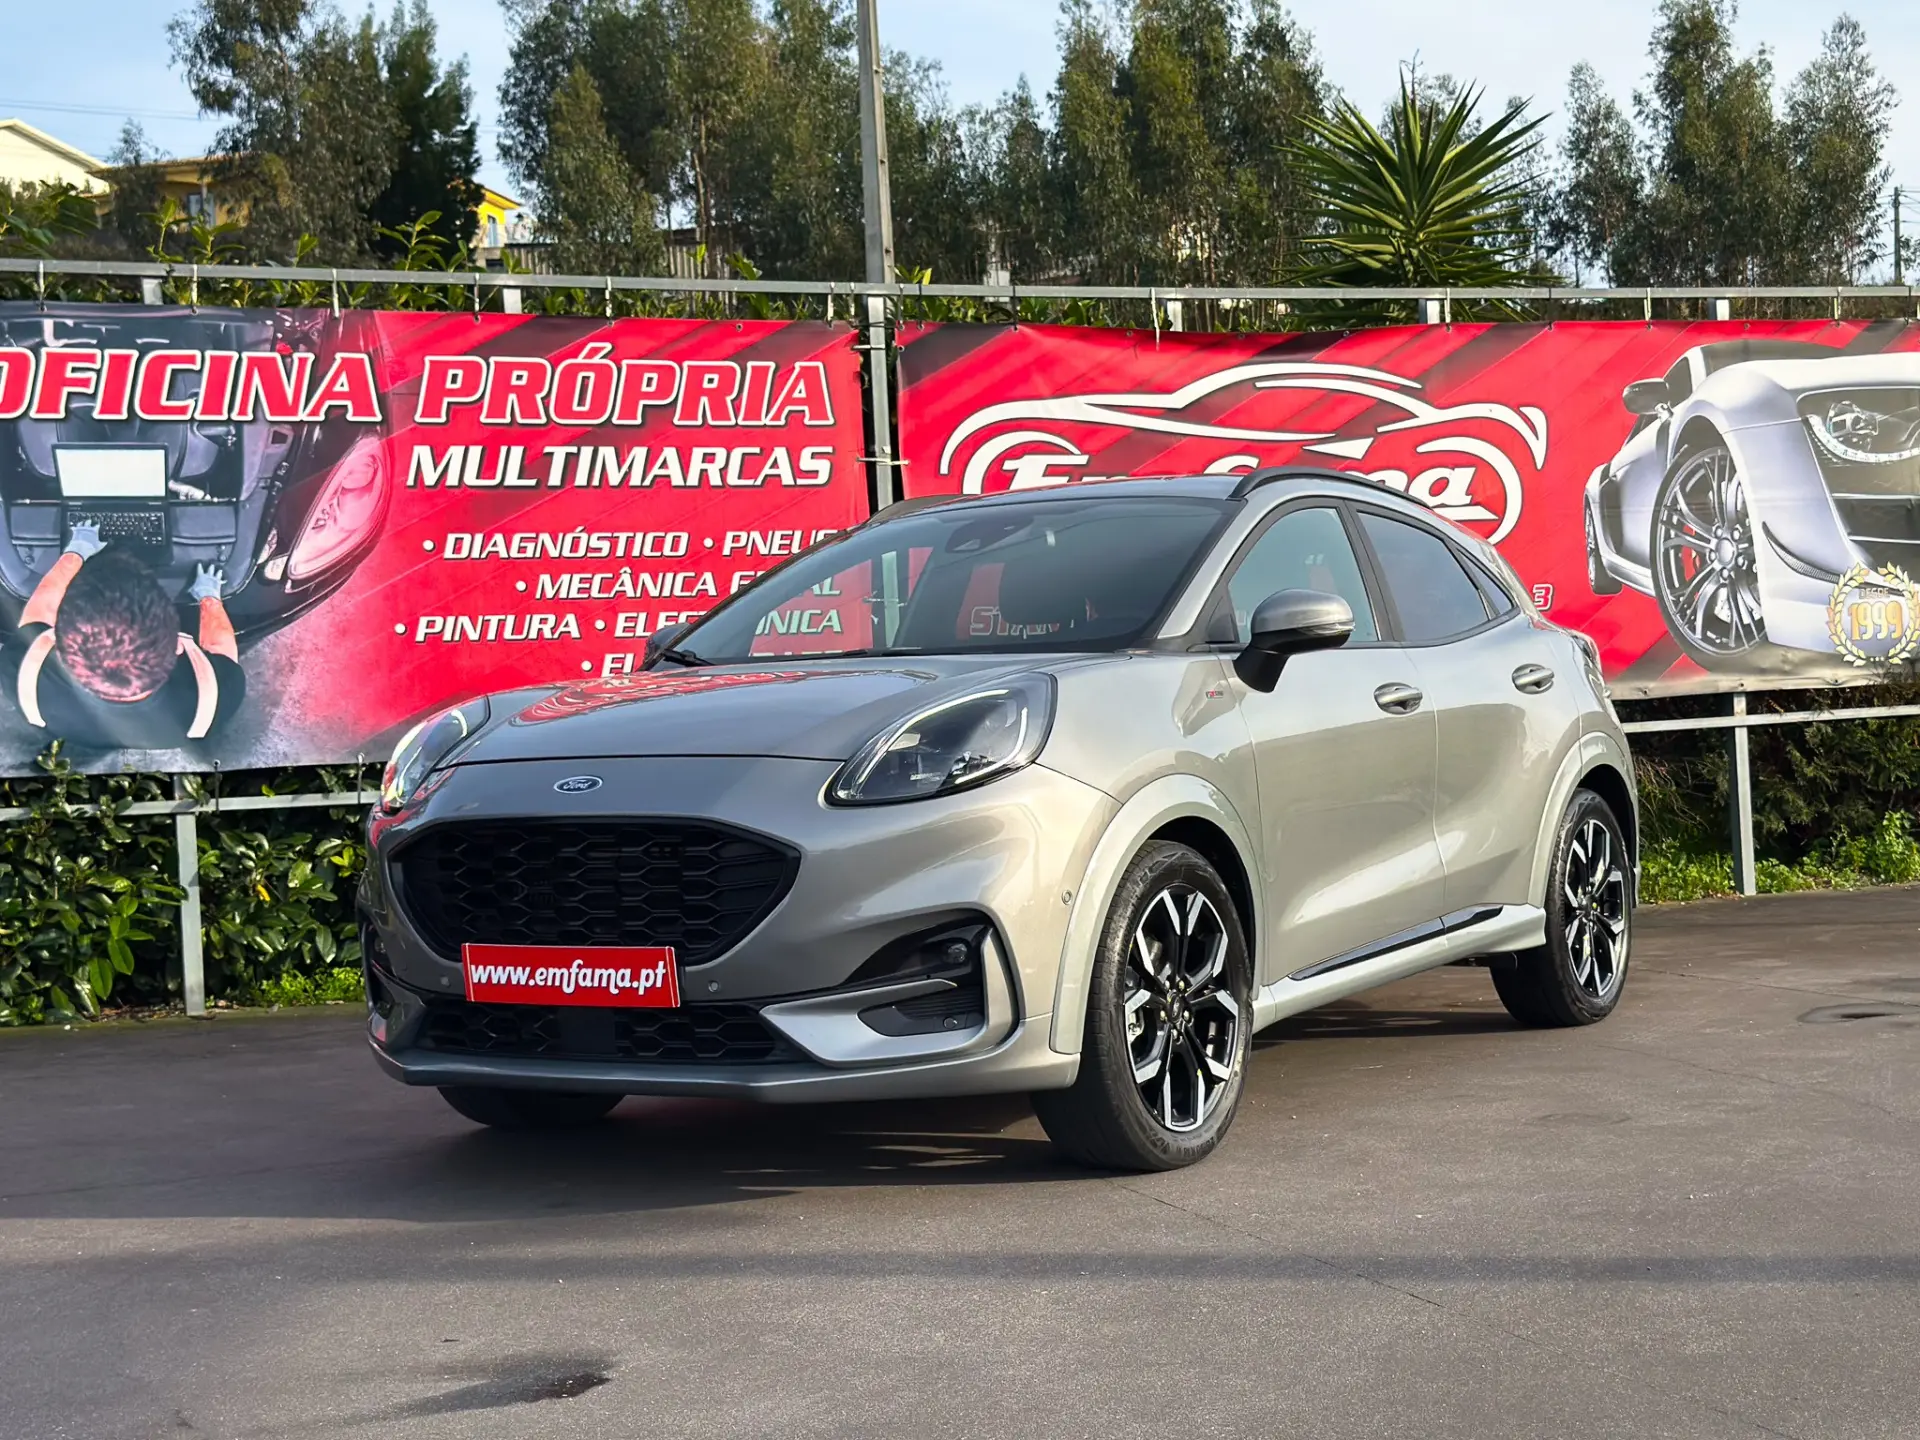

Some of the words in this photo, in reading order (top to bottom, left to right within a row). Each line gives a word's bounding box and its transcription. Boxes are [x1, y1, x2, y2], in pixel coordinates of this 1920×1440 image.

[414, 342, 836, 425] PRÓPRIA
[406, 444, 834, 488] MULTIMARCAS
[443, 527, 690, 559] DIAGNÓSTICO
[535, 567, 718, 599] MECÂNICA
[415, 613, 581, 642] PINTURA
[1848, 601, 1903, 641] 1999
[470, 959, 667, 995] www.emfama.pt
